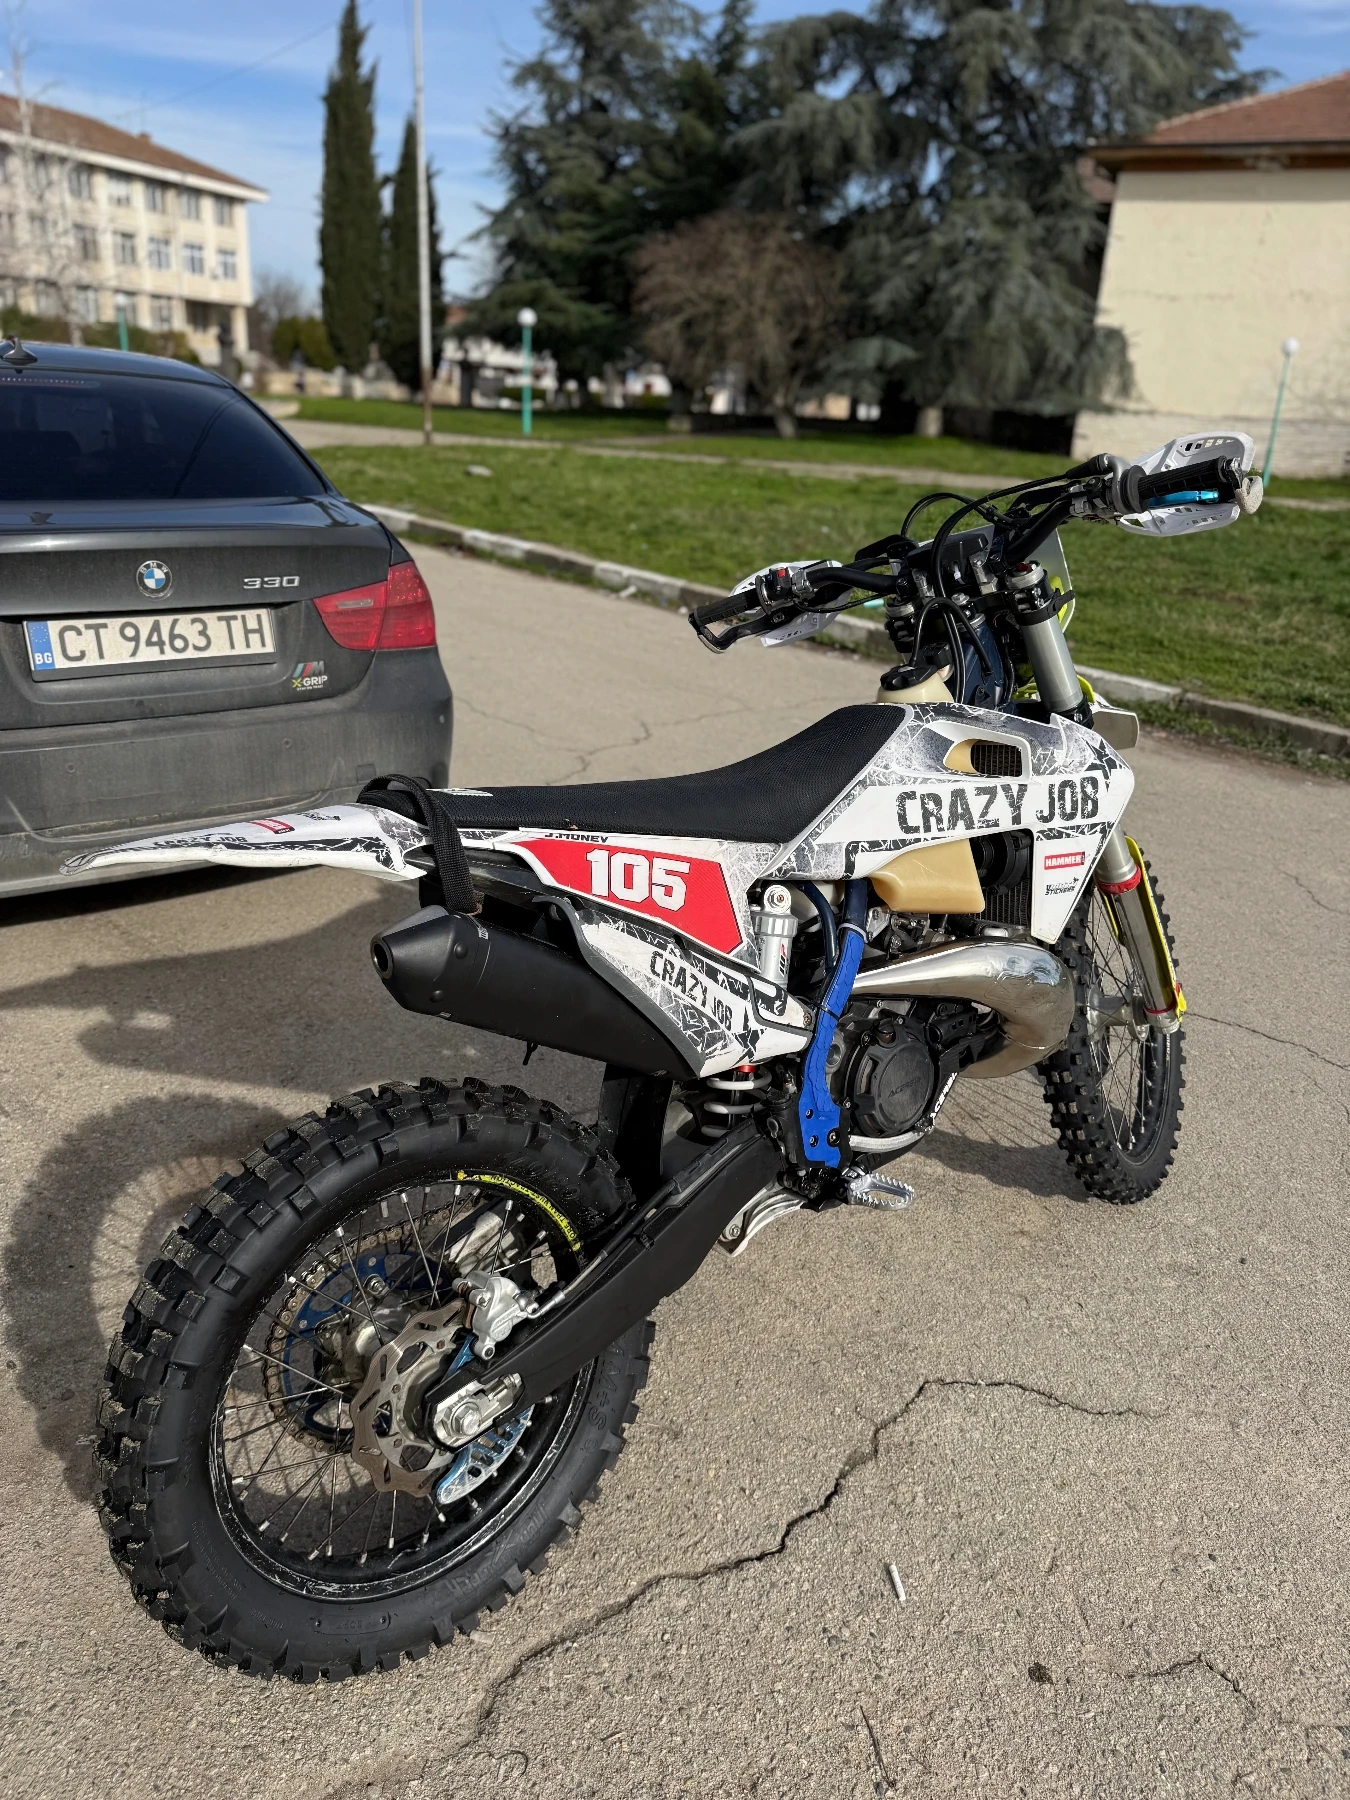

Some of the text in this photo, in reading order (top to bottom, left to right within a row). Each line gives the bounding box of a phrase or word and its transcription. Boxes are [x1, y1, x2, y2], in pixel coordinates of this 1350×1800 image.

[243, 576, 300, 589] 330
[58, 613, 266, 662] CT 9463 TH
[34, 653, 52, 665] BG
[292, 675, 328, 688] X-GRIP
[896, 776, 1099, 835] CRAZY JOB
[1045, 855, 1082, 867] HAMMER
[586, 848, 690, 912] 105
[650, 950, 733, 1031] CRAZY JOB
